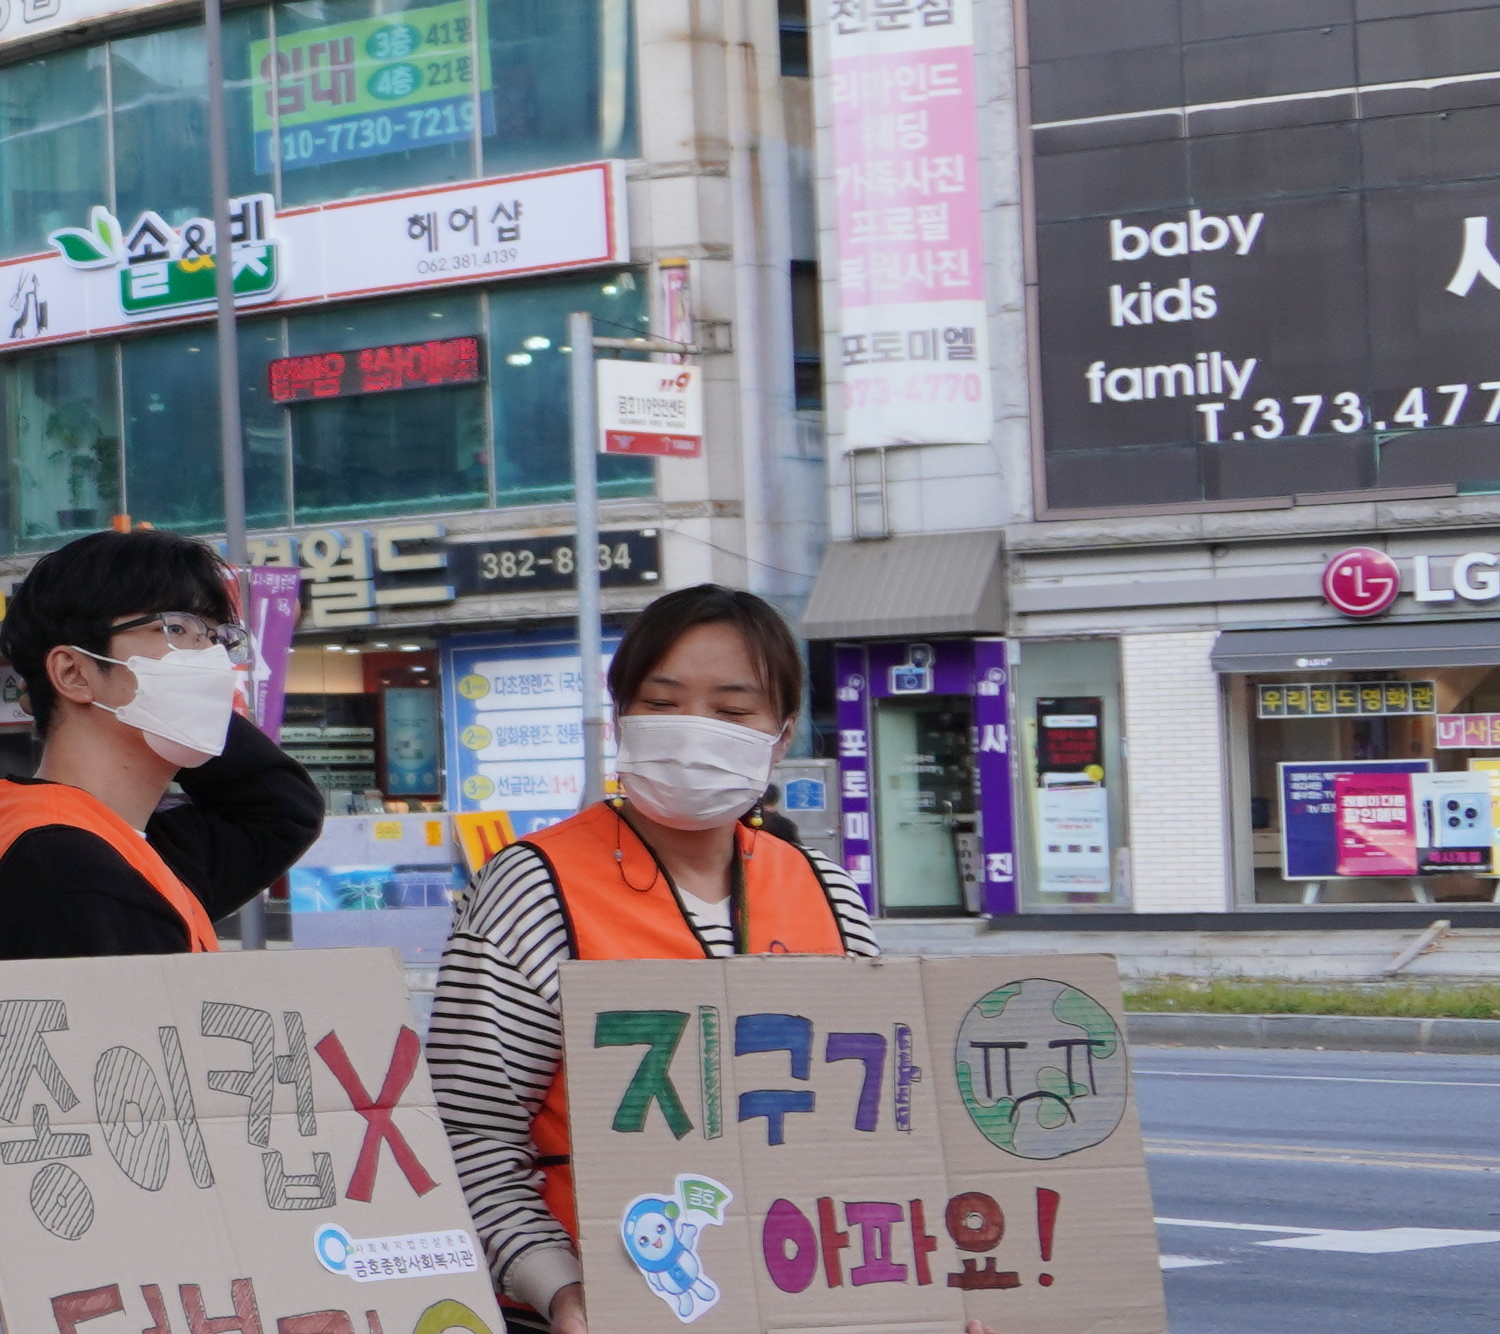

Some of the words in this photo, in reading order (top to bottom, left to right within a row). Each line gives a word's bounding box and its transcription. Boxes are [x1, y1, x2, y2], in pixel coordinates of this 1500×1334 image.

[260, 35, 357, 118] 임대
[831, 61, 963, 107] 리마인드
[835, 155, 966, 200] 가족사진
[405, 199, 523, 253] 헤어샵
[848, 201, 950, 245] 프로필
[1109, 208, 1265, 262] baby
[416, 247, 518, 276] 062.381.4139
[1109, 277, 1218, 327] kids
[840, 325, 978, 367] 포토미엘
[1085, 351, 1258, 404] family
[481, 543, 632, 580] 382-834
[493, 673, 555, 696] 다초점렌즈
[497, 773, 549, 798] 선글라스
[552, 774, 578, 796] 1+1
[593, 1004, 923, 1147] 지구가
[762, 1186, 1061, 1294] 아파요!
[353, 1249, 476, 1278] 금호종합사회복지관
